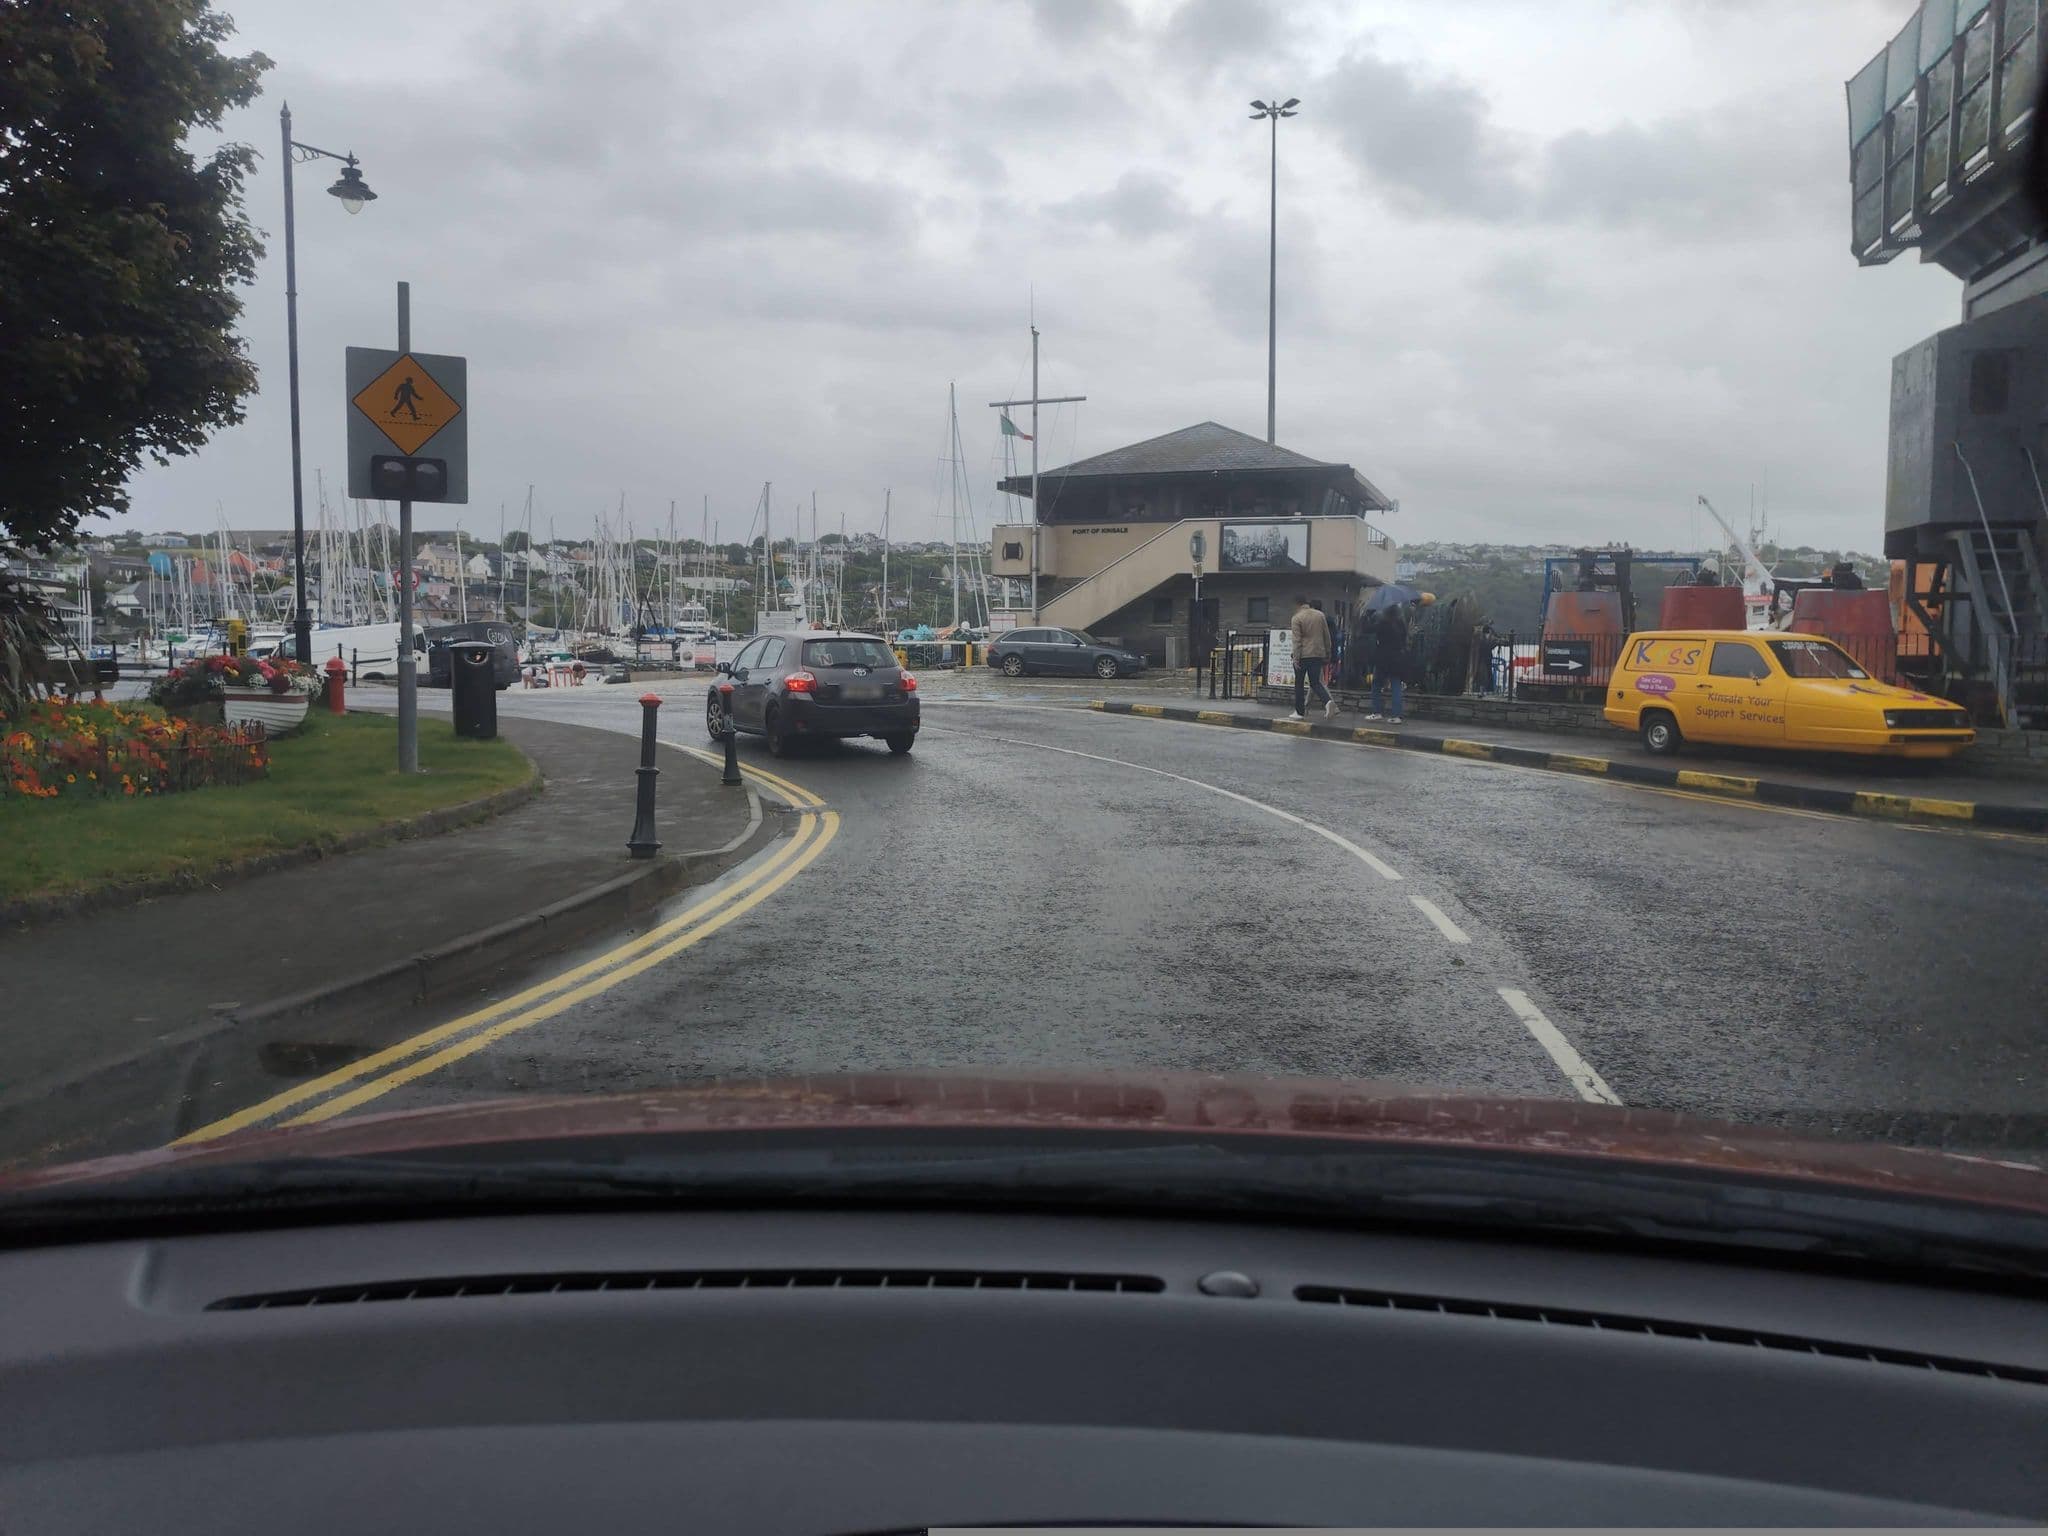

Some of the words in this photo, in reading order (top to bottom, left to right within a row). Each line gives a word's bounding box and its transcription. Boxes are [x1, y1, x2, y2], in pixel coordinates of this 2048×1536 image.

[820, 654, 833, 665] N
[1708, 693, 1743, 704] Kinsale
[1749, 695, 1773, 706] Your
[1696, 706, 1735, 719] Support
[1740, 710, 1785, 724] Services
